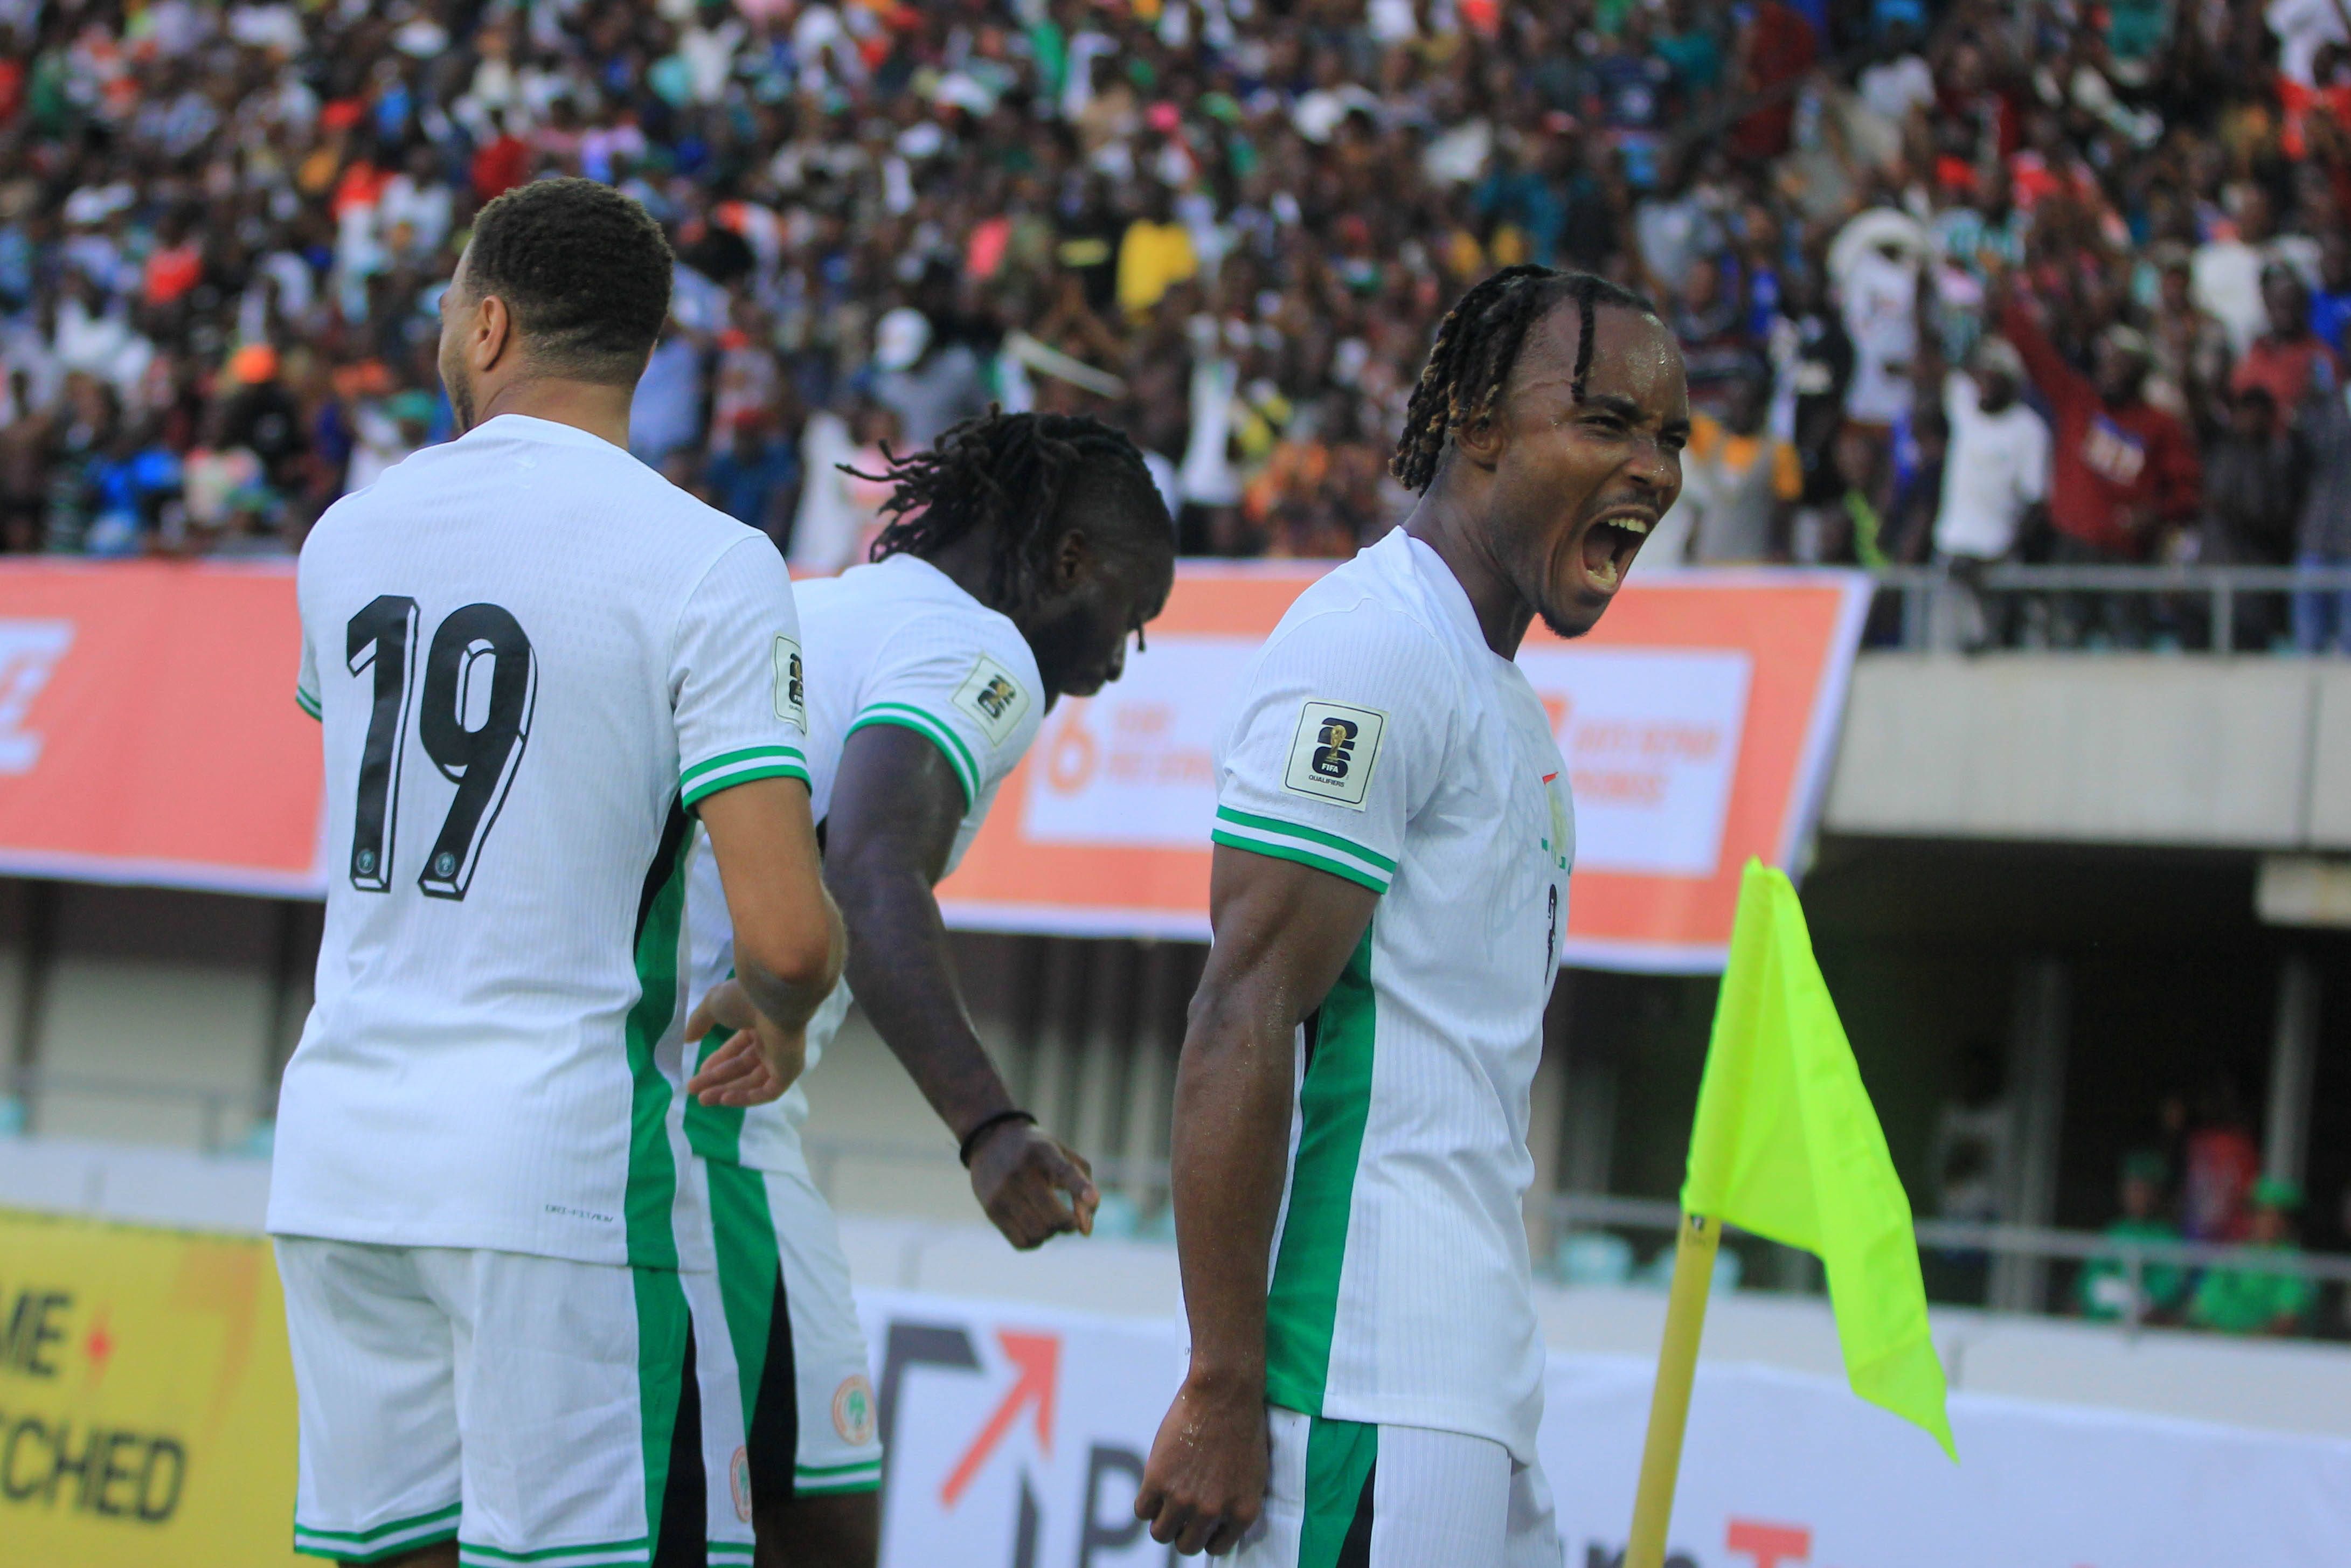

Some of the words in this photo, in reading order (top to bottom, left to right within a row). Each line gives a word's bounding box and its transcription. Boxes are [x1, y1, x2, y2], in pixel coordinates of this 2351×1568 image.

[346, 594, 538, 902] 19
[1321, 763, 1339, 773] FIFA
[1308, 775, 1344, 787] QUALIFIERS
[0, 1407, 186, 1524] CHED
